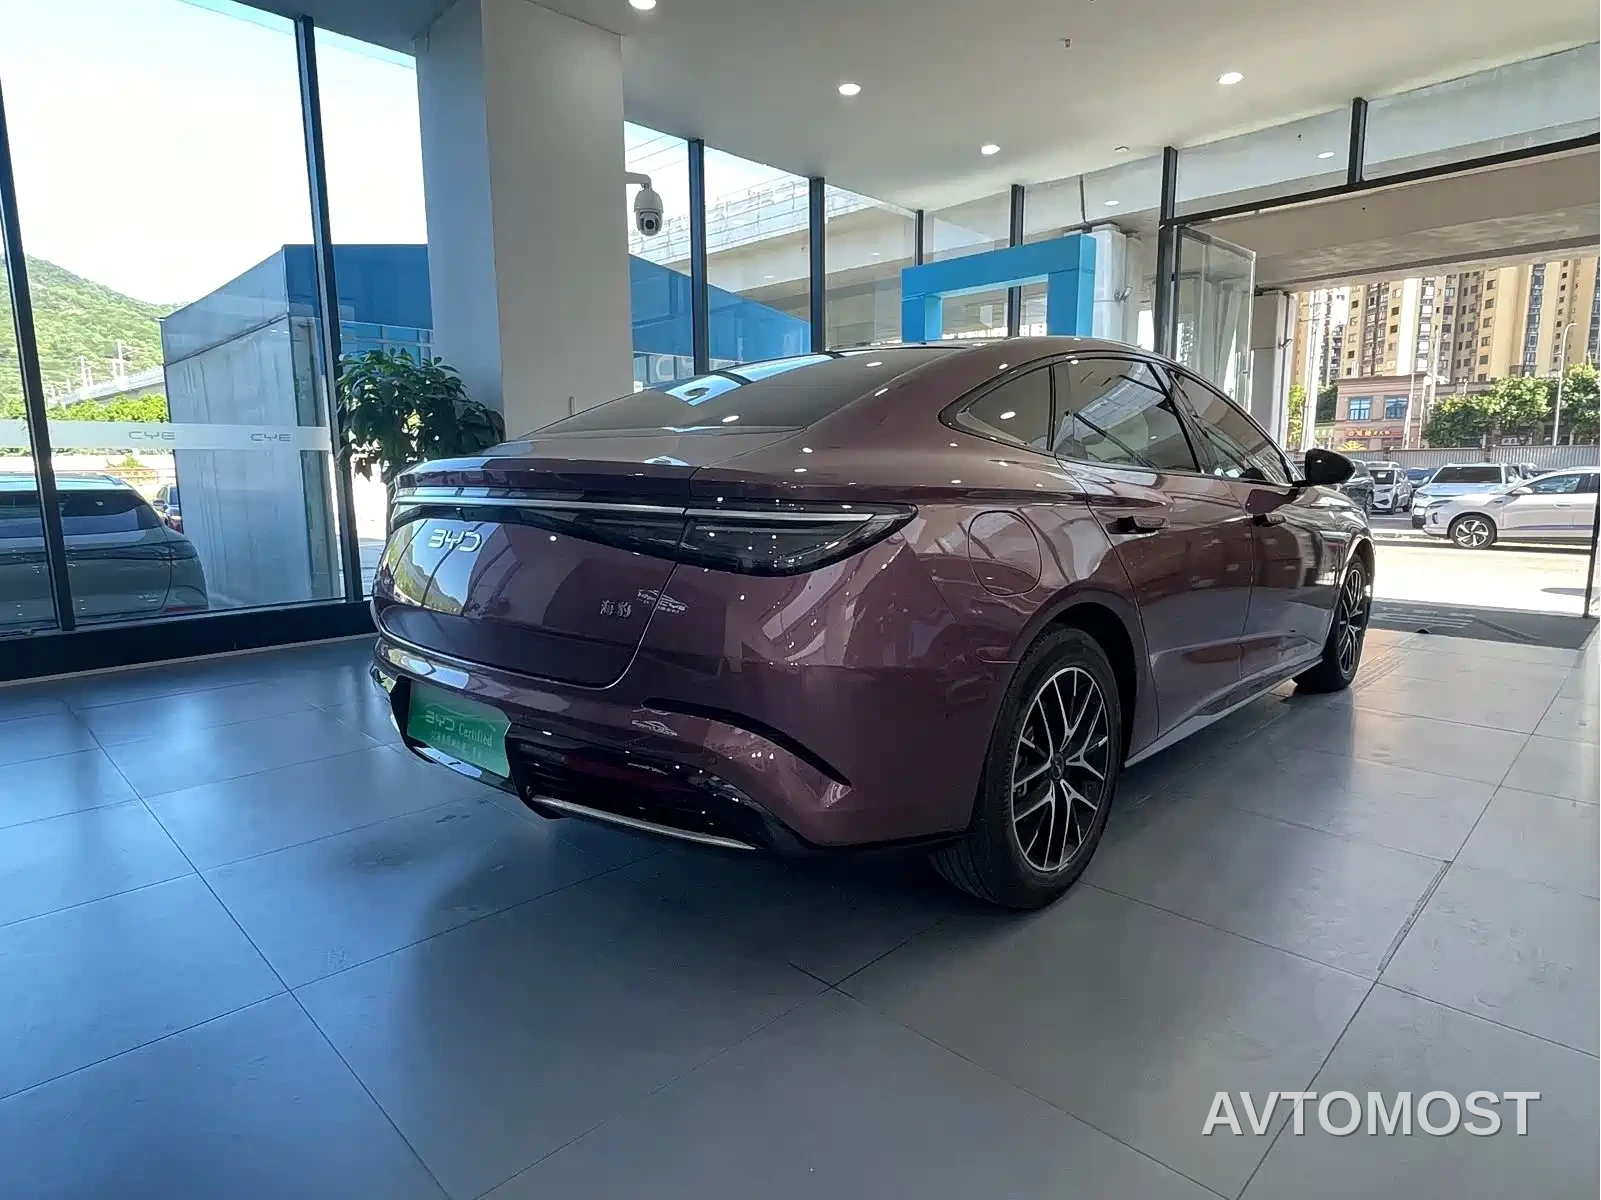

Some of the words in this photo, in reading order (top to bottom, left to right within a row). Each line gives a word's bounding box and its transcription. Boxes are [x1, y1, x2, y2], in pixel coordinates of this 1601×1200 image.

[428, 529, 481, 552] BYD
[425, 709, 455, 731] BYD
[458, 722, 493, 748] Certified
